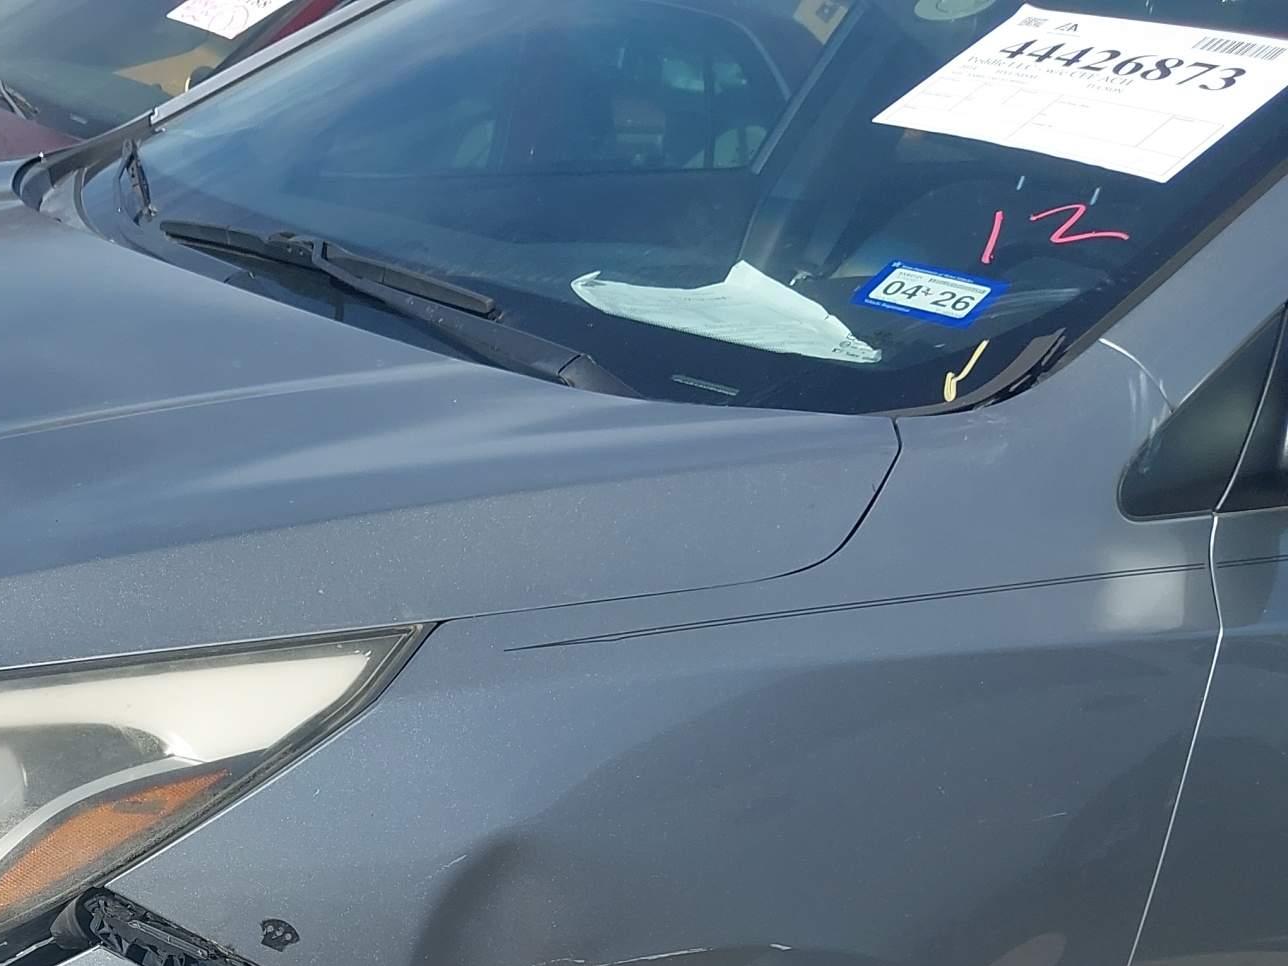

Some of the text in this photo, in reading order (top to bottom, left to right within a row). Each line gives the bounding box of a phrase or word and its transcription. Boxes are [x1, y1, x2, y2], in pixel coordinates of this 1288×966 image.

[999, 39, 1246, 90] 44426873
[882, 280, 923, 299] 04
[930, 291, 975, 311] 26
